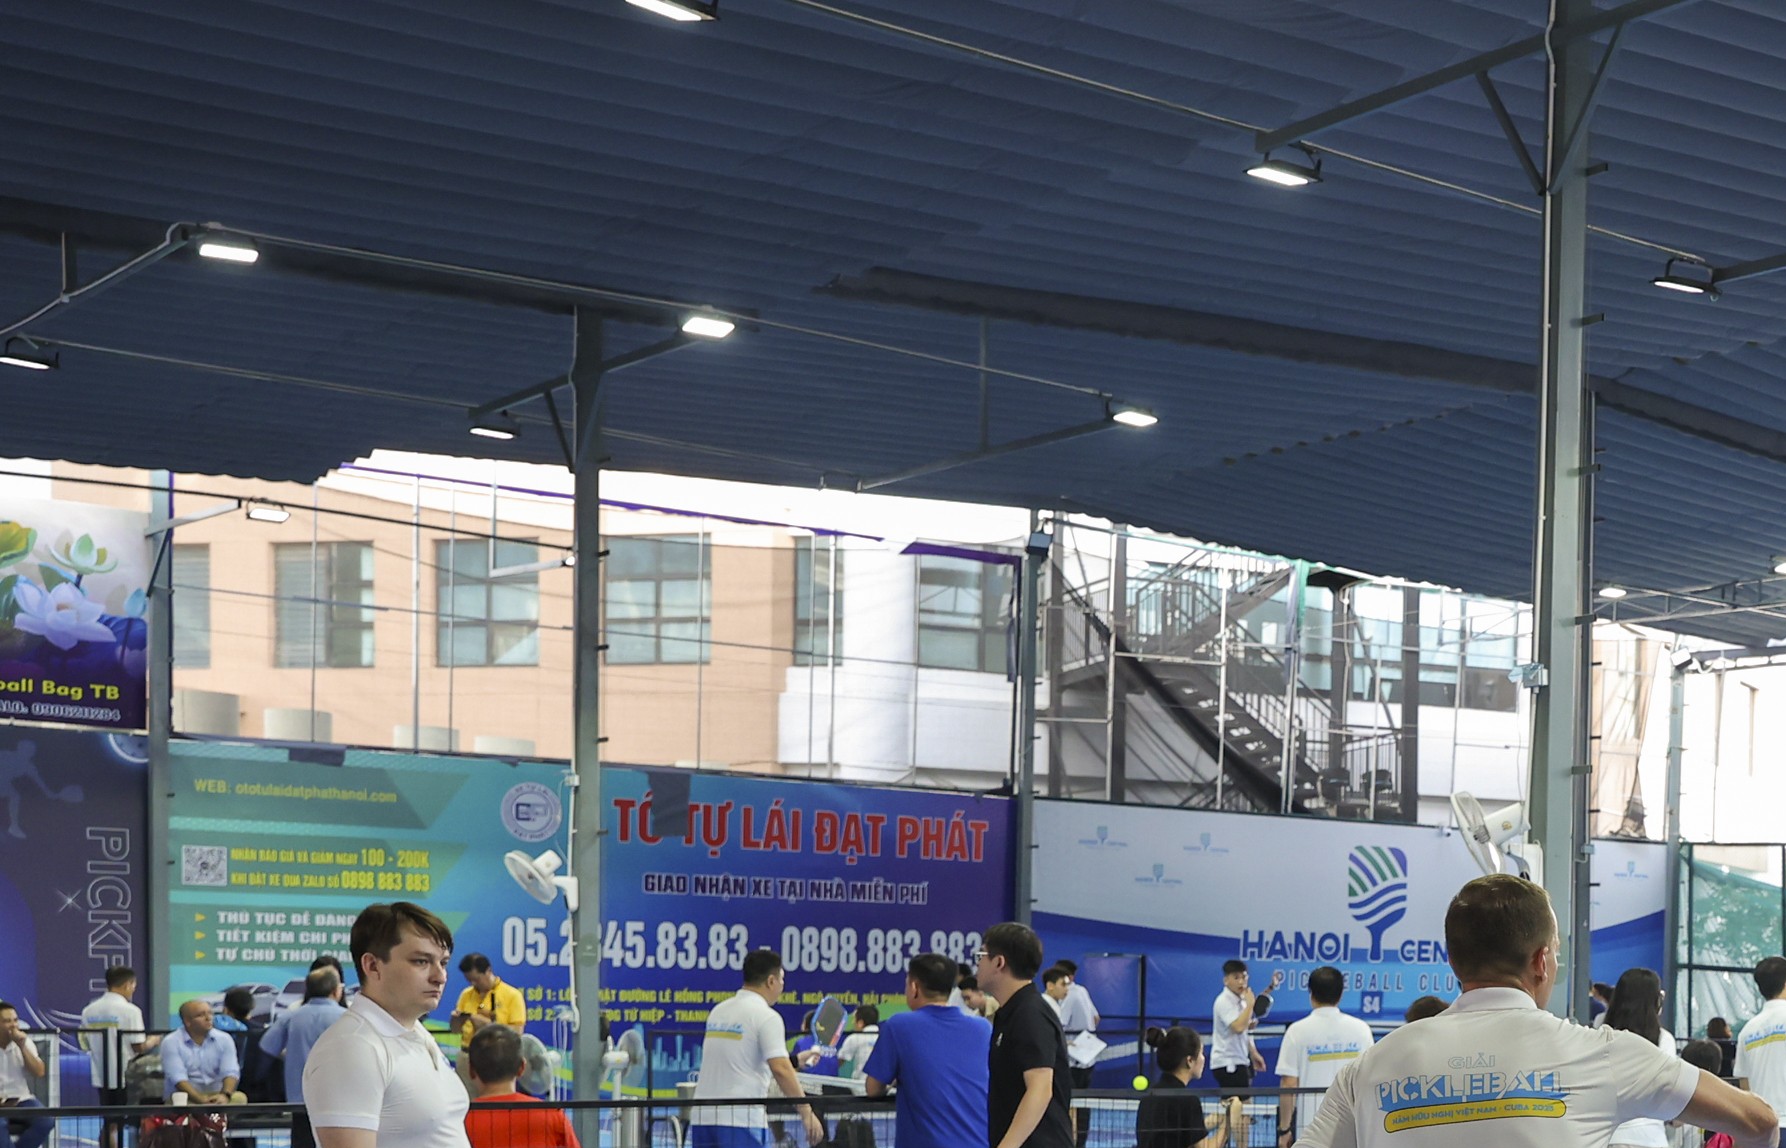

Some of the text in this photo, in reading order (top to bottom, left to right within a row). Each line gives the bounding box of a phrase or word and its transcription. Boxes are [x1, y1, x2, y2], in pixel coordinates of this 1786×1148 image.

[42, 680, 83, 700] Bag
[90, 683, 119, 700] TB
[194, 778, 231, 794] WEB:
[742, 799, 802, 852] LÁI
[814, 811, 887, 866] ĐẠT
[896, 810, 989, 863] PHÁT
[362, 848, 385, 867] 100
[396, 850, 430, 869] 200K
[377, 871, 402, 891] 883
[405, 872, 430, 892] 883
[643, 873, 688, 895] GIAO
[694, 874, 746, 902] NHẬN
[751, 877, 772, 897] XE
[778, 879, 804, 904] TẠI
[850, 877, 895, 903] MIỄN
[899, 881, 929, 905] PHÍ
[216, 927, 250, 943] TIẾT
[255, 929, 295, 945] KIỆM
[299, 931, 326, 945] CHI
[1241, 929, 1350, 961] HANOI
[1362, 995, 1381, 1013] S4
[1448, 1052, 1496, 1070] GIẢI
[1375, 1069, 1571, 1111] PICKLEBALL
[1477, 1106, 1497, 1115] NAM
[1504, 1103, 1529, 1112] CUBA
